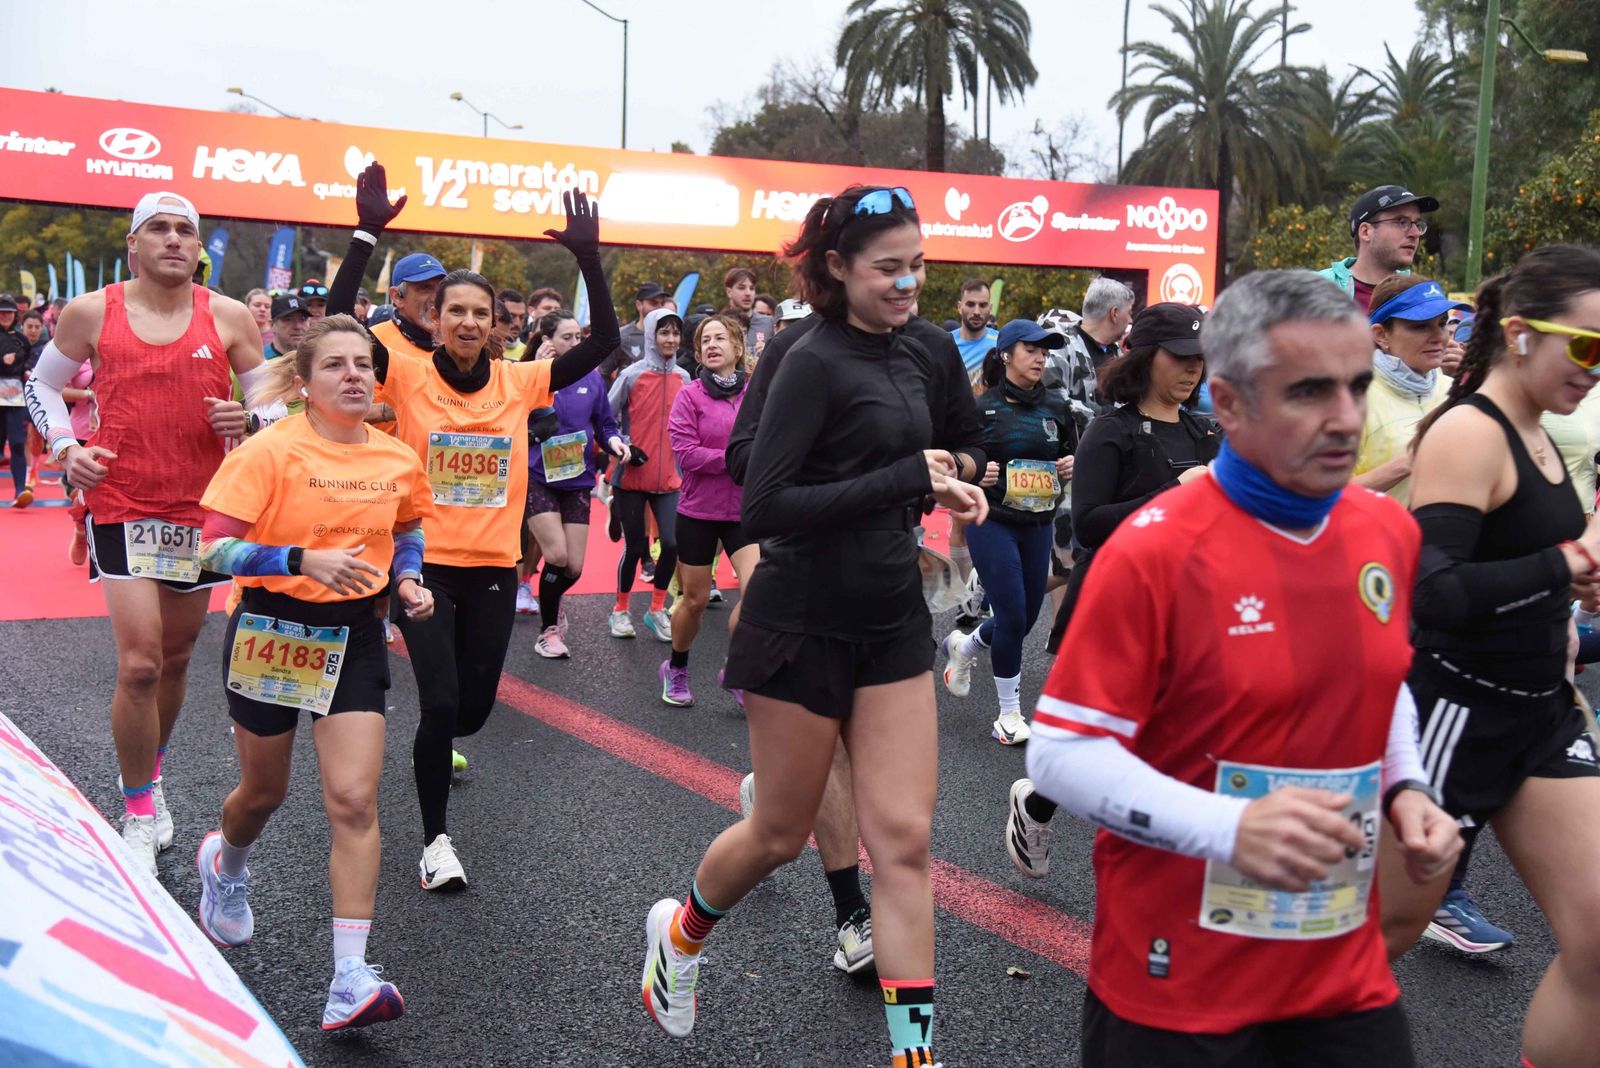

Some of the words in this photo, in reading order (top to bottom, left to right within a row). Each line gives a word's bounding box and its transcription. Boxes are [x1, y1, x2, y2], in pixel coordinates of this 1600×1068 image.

[86, 158, 174, 181] HYUNDAI
[193, 145, 306, 187] HOKA
[752, 189, 832, 222] HOK
[436, 450, 499, 475] 14936
[309, 478, 367, 491] RUNNING
[371, 481, 398, 492] CLUB
[132, 524, 194, 548] 21651
[330, 526, 366, 536] HOLMES
[366, 527, 390, 537] PLACE
[243, 636, 327, 671] 14183
